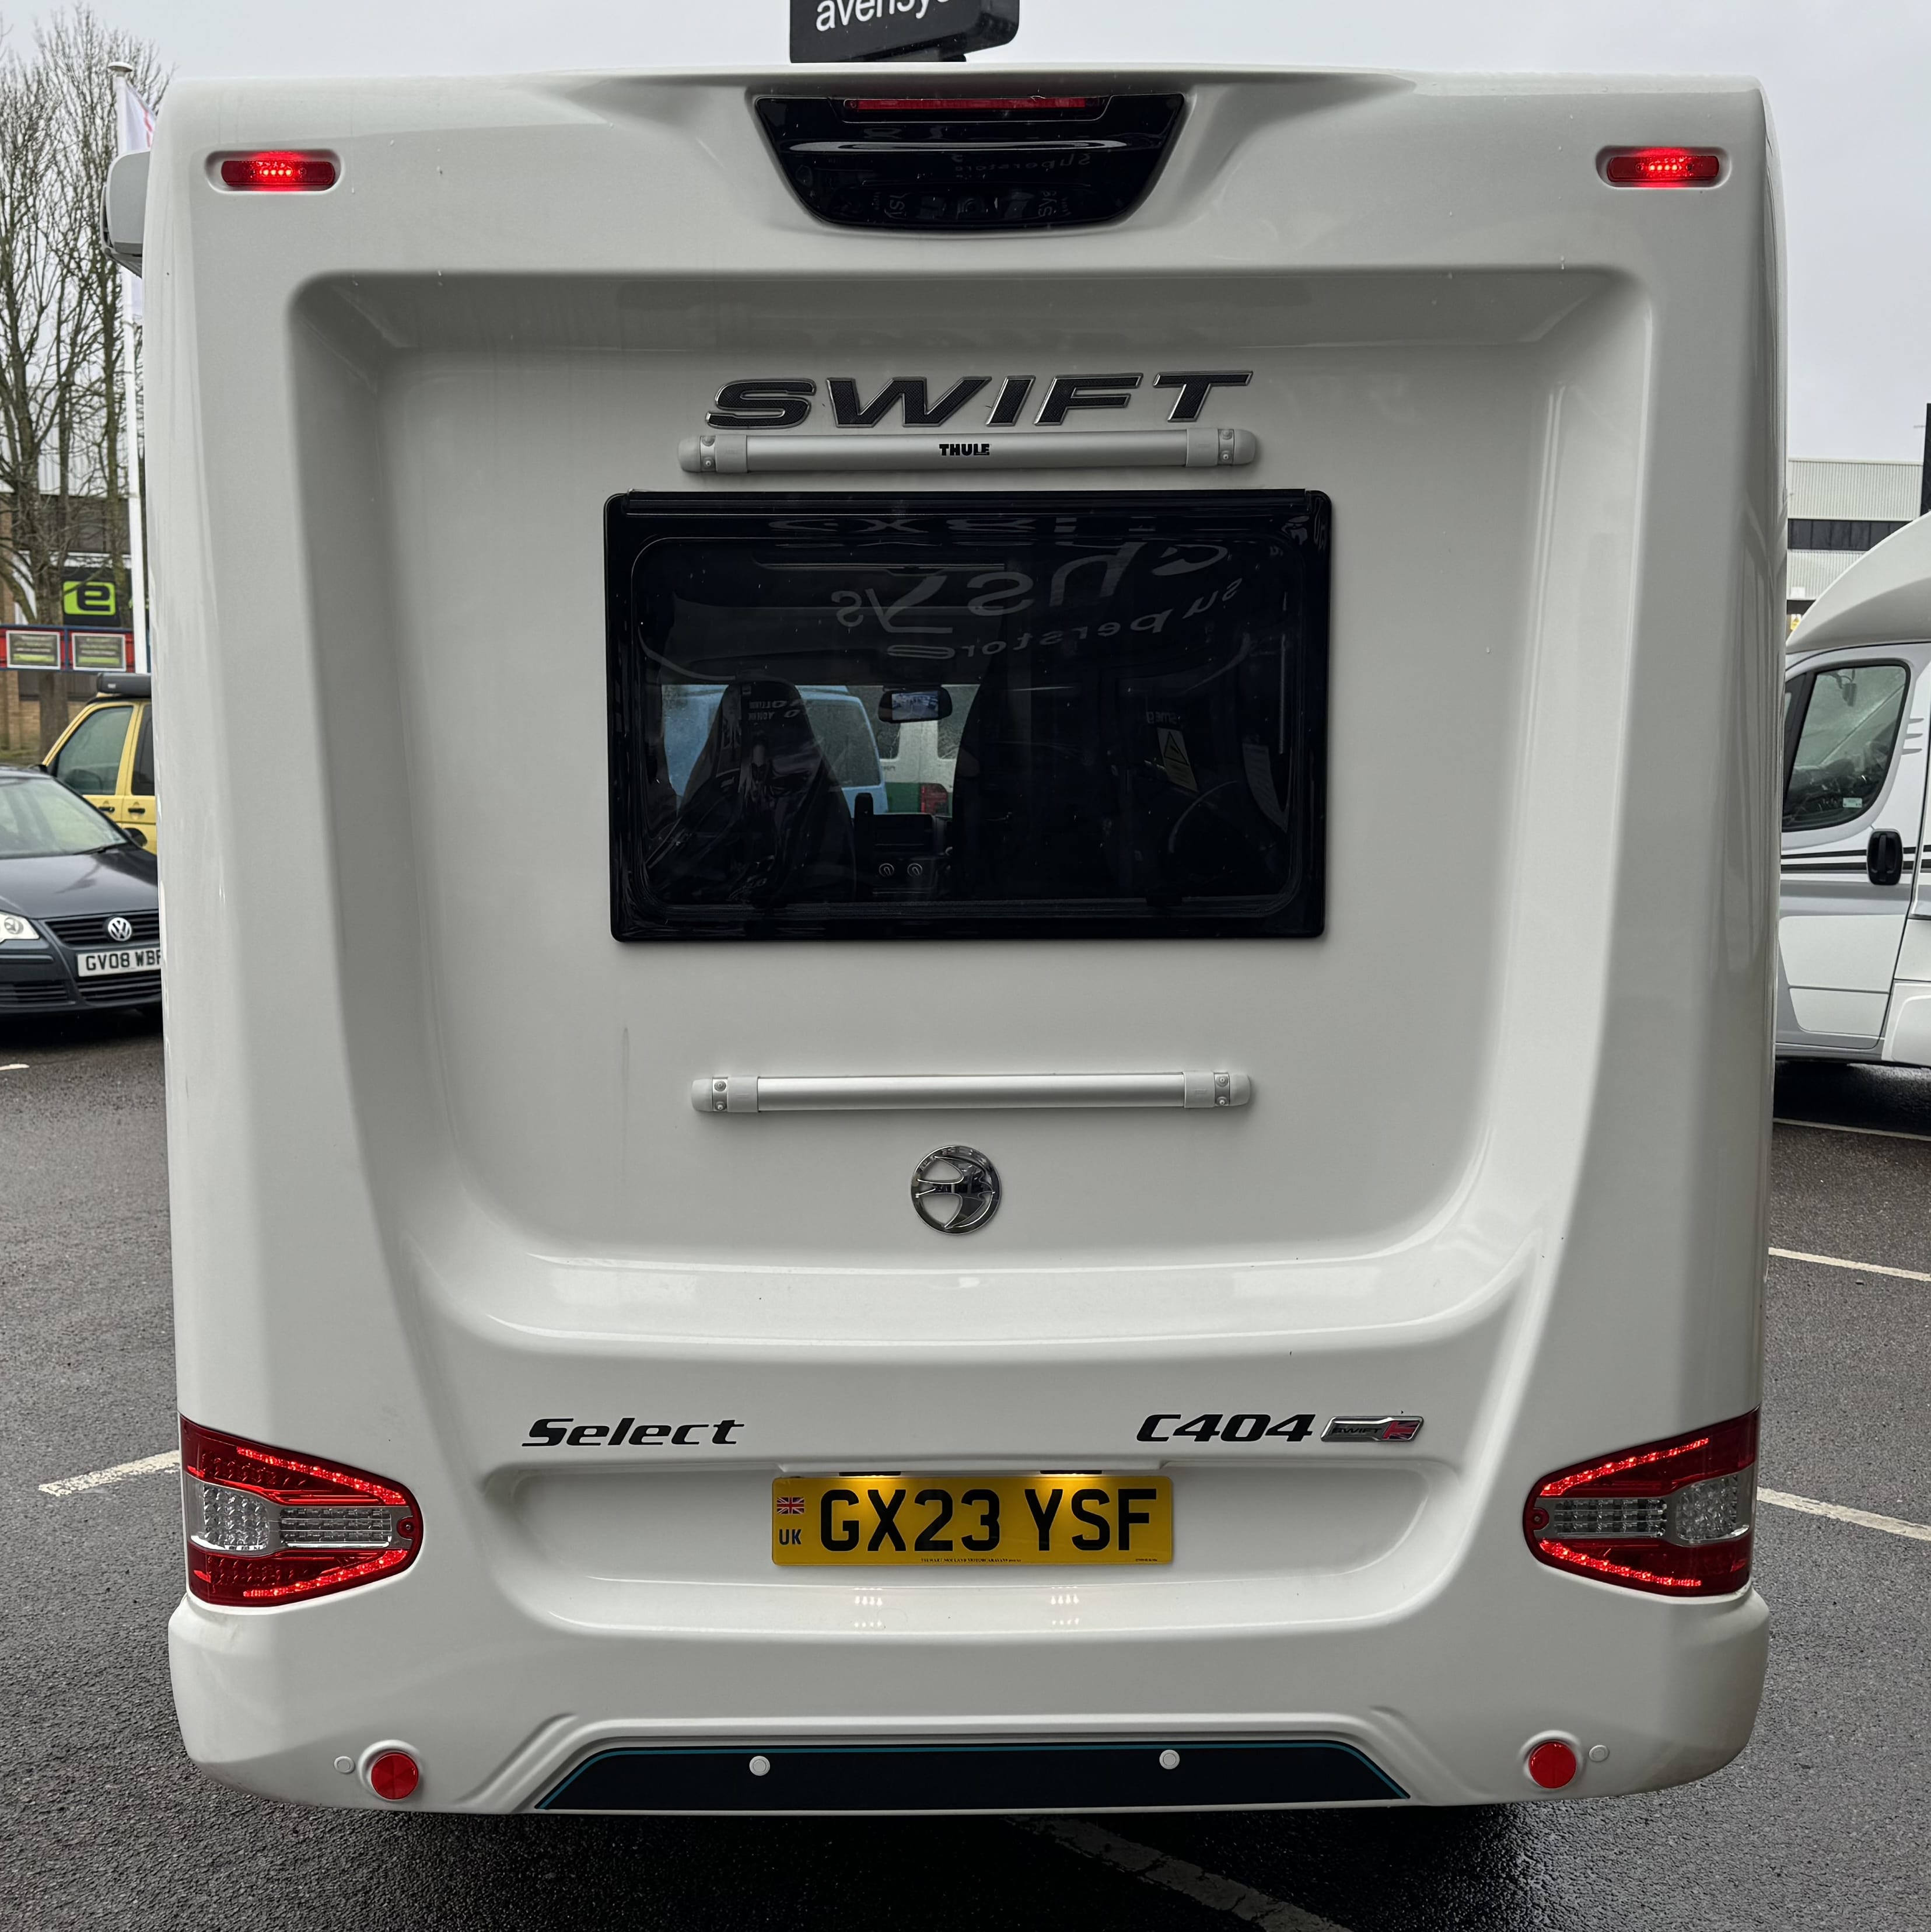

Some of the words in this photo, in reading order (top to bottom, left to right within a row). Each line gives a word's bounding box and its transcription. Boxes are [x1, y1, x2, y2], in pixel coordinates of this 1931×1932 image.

[816, 0, 949, 31] aveny
[706, 371, 1254, 428] SWIFT
[939, 443, 990, 456] THULE
[86, 952, 130, 970] GV08
[522, 1417, 744, 1447] Select
[1136, 1414, 1316, 1442] C404
[820, 1489, 1000, 1552] GX23
[1024, 1489, 1157, 1551] YSF
[779, 1529, 802, 1546] UK
